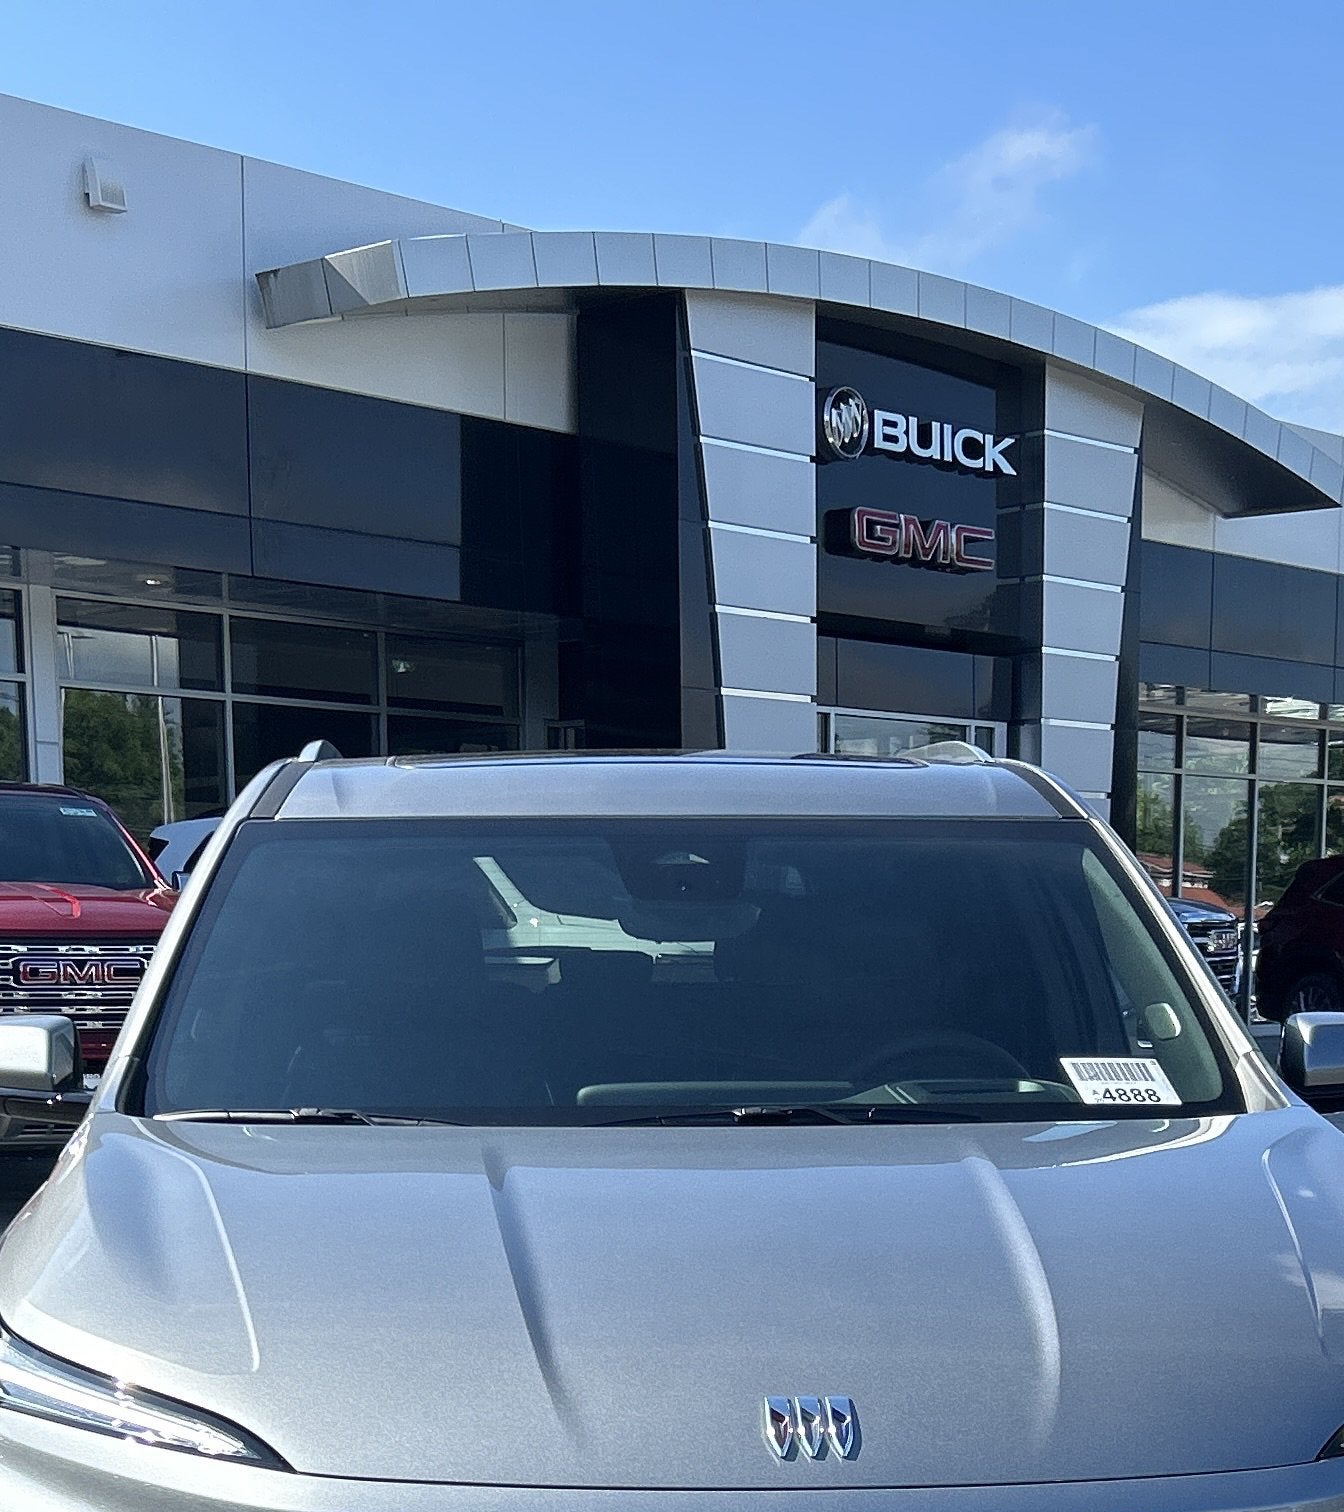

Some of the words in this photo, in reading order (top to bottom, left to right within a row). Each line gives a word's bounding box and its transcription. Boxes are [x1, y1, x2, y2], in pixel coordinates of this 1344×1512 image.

[873, 408, 1018, 477] BUICK
[853, 505, 995, 571] GMC
[19, 960, 141, 985] GMC
[1103, 1088, 1161, 1102] 4888
